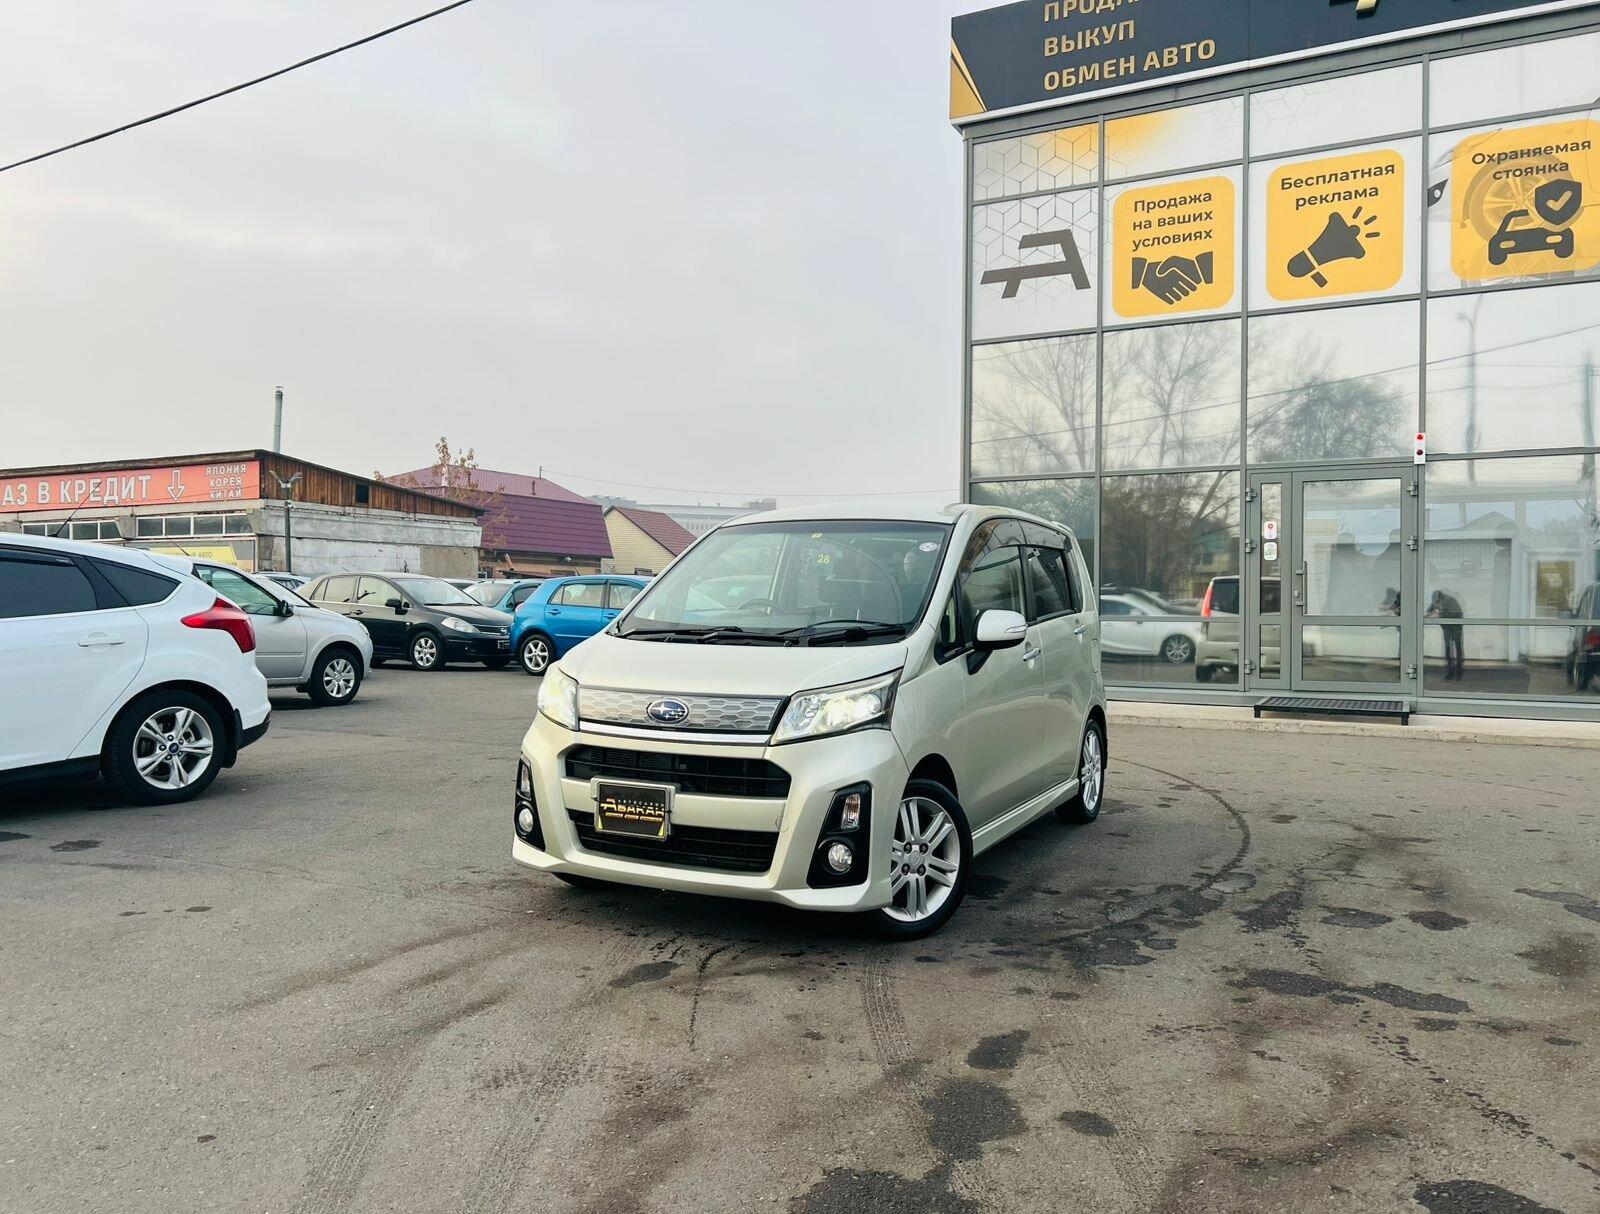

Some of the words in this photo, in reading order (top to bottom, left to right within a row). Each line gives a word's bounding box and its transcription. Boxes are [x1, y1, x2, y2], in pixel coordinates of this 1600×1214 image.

[1044, 0, 1142, 22] ПРОД
[1044, 19, 1136, 57] ВЫКУП
[1044, 55, 1136, 91] ОБМЕН
[1143, 39, 1217, 72] АВТО
[1471, 140, 1592, 165] Охраняемая
[1281, 164, 1396, 190] Бесплатная
[1493, 162, 1570, 181] стоянка
[1134, 192, 1212, 213] Продажа
[1295, 187, 1379, 211] реклама
[1132, 219, 1153, 231] на
[1157, 210, 1213, 228] ваших
[1132, 229, 1213, 252] условиях
[206, 464, 246, 475] ЯПОНИЯ
[37, 481, 51, 504] В
[60, 475, 152, 505] КРЕДИТ
[209, 476, 242, 488] КОРЕЯ
[817, 553, 831, 564] 28
